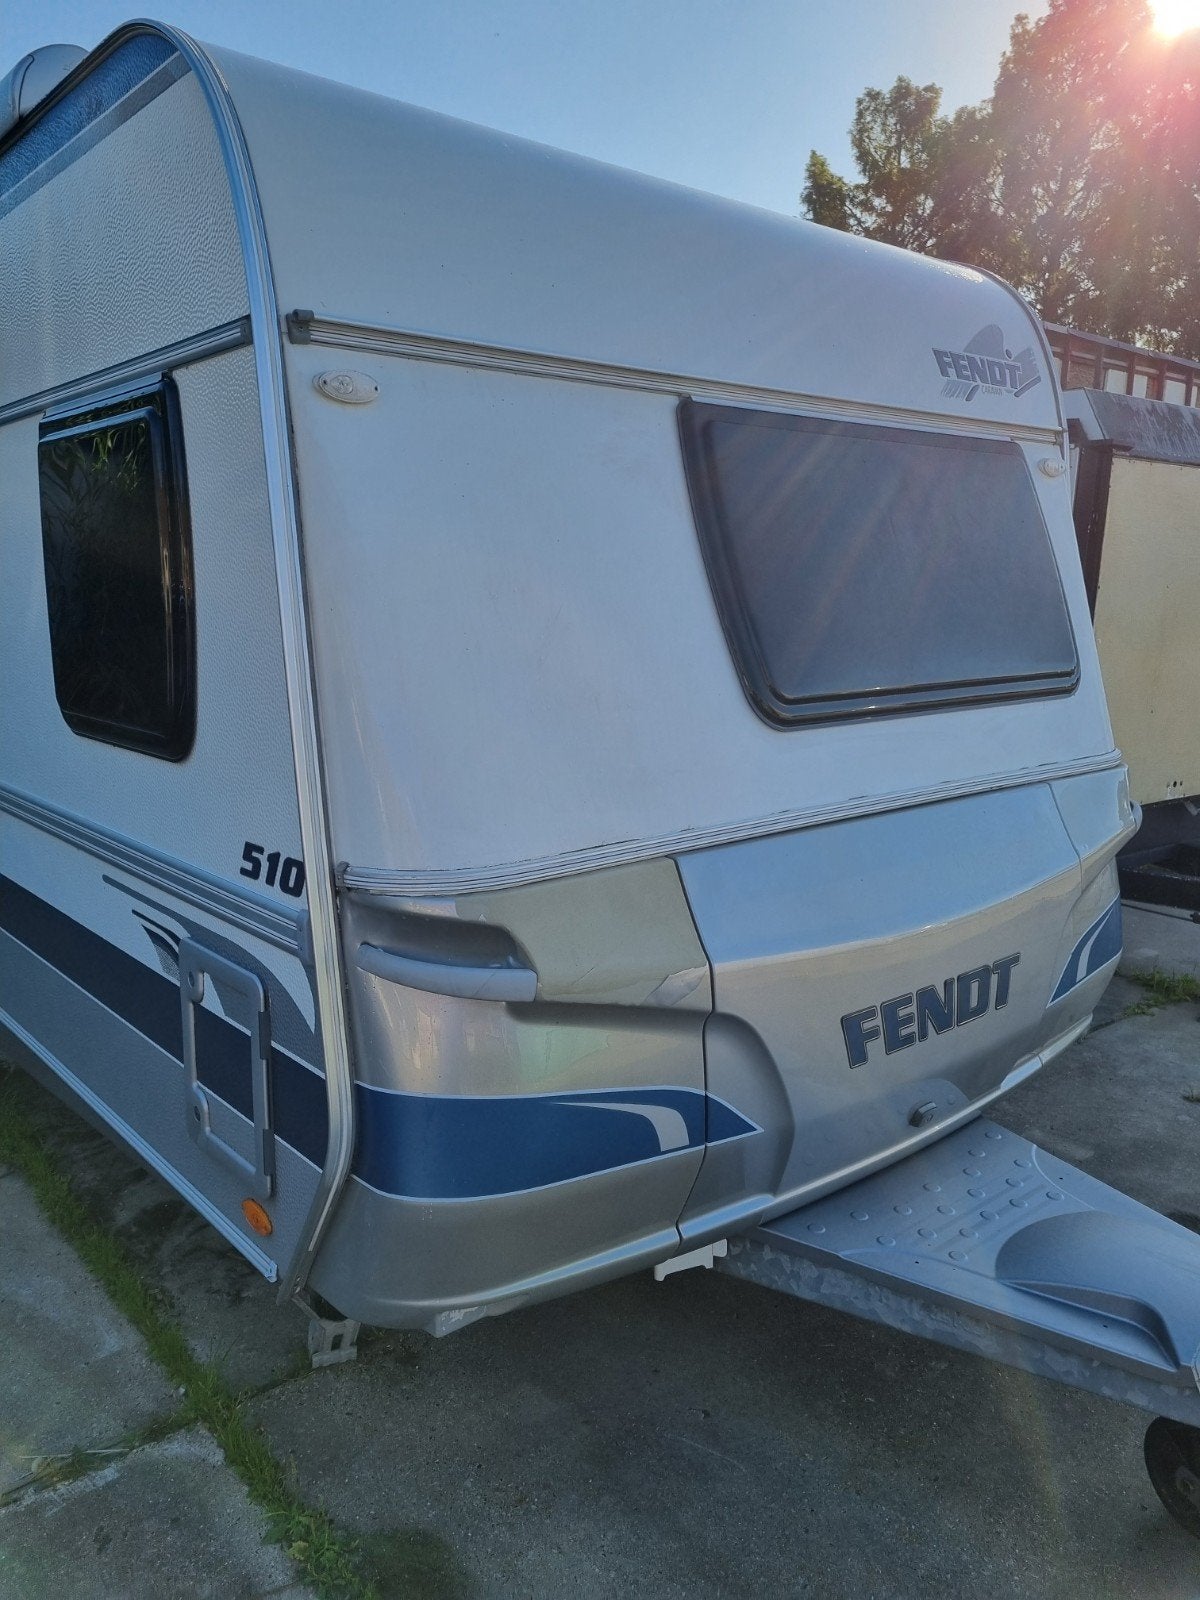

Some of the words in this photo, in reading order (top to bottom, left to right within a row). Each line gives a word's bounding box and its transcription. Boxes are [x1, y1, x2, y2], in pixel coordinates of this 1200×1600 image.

[932, 347, 1021, 390] FENDT
[240, 841, 305, 897] 510
[840, 952, 1021, 1069] FENDT
